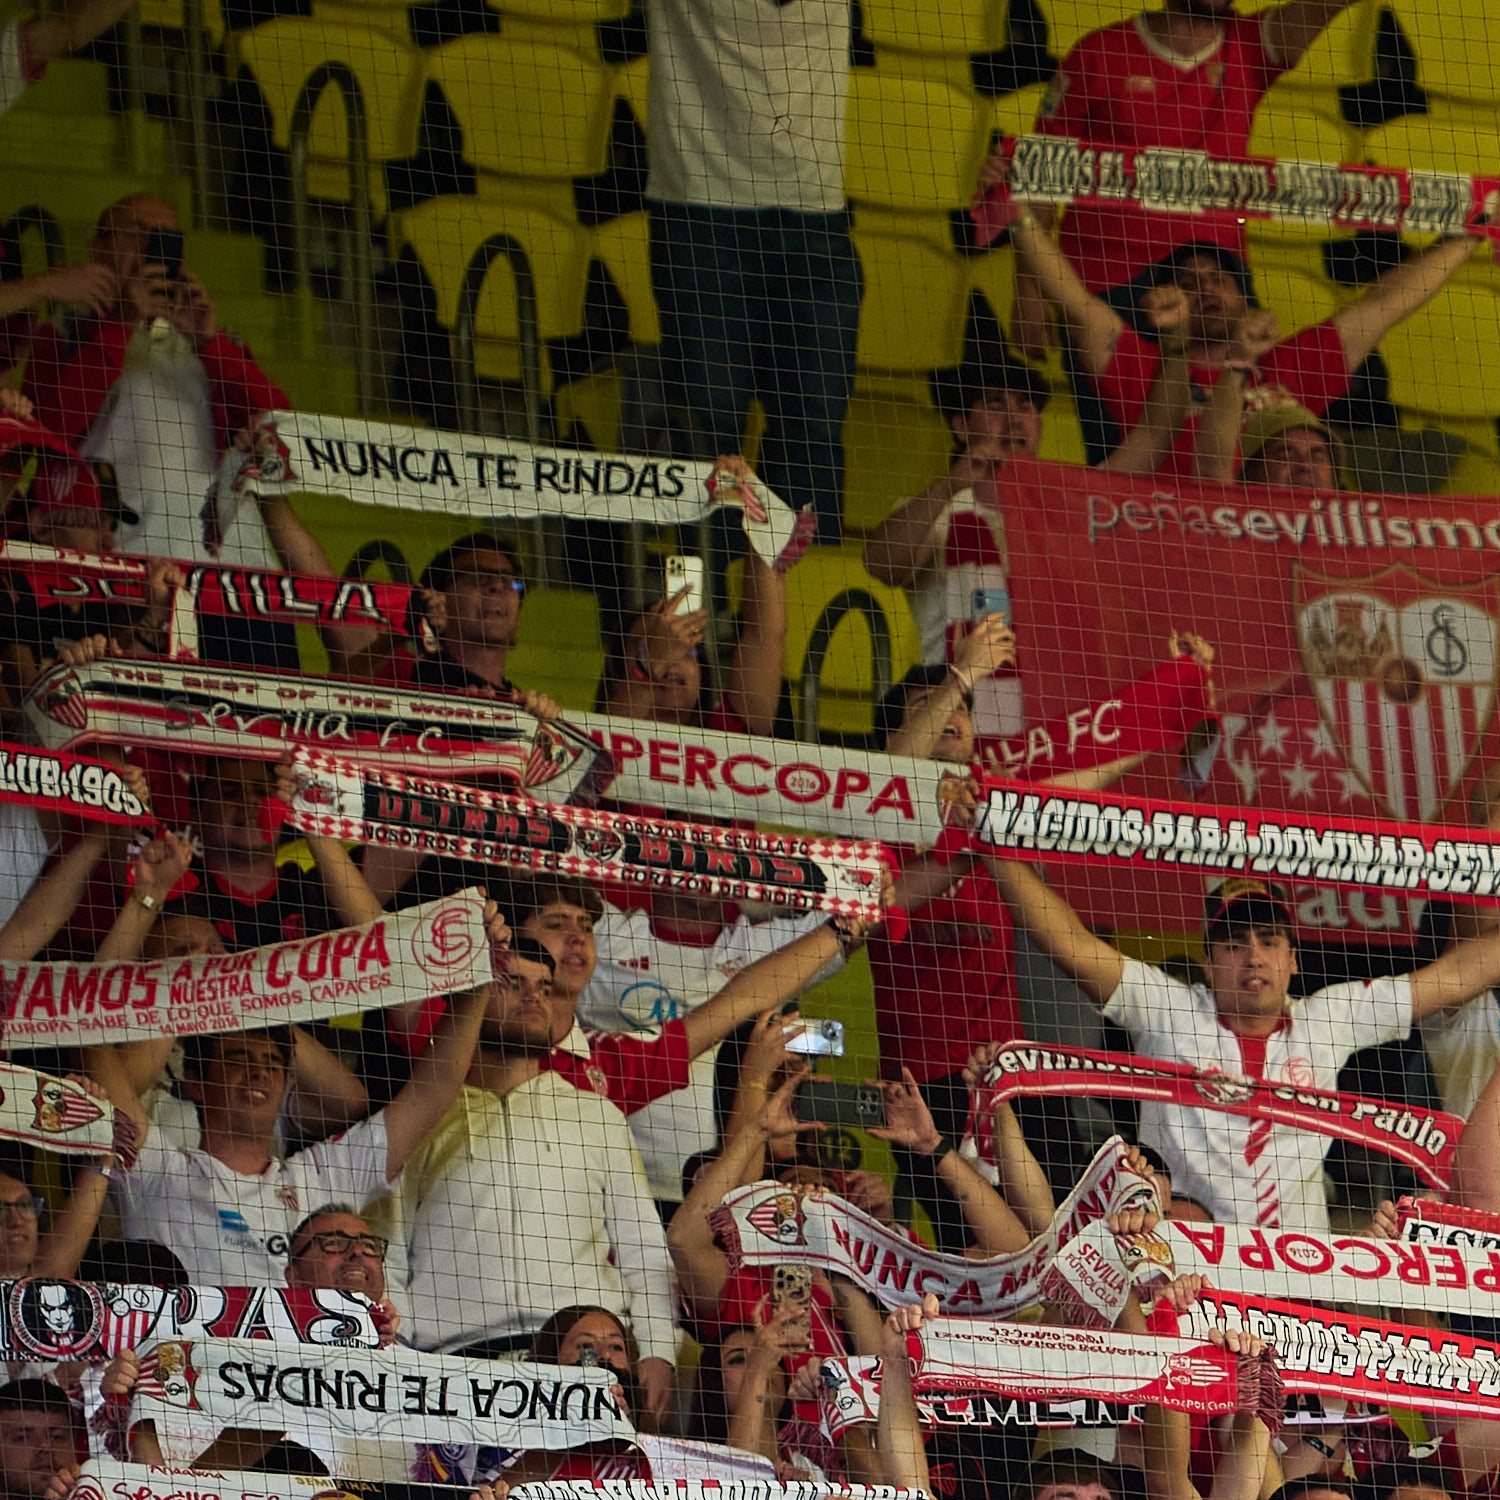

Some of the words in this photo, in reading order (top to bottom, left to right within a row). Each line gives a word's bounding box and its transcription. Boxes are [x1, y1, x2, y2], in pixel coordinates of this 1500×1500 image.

[304, 436, 459, 489] NUNCA
[466, 452, 522, 491] TE
[532, 455, 687, 500] RINDAS
[109, 667, 164, 685] THE
[275, 687, 316, 701] OF
[334, 694, 393, 710] THE
[409, 703, 514, 723] WORLD
[590, 728, 915, 820] PERCOPA
[362, 823, 462, 853] NOSOTROS
[722, 878, 752, 899] DEL
[202, 952, 256, 976] POR
[265, 921, 391, 988] COPA
[78, 1014, 126, 1031] SABE
[135, 1011, 161, 1026] DE
[166, 1008, 189, 1022] LO
[198, 1003, 233, 1020] QUE
[241, 991, 303, 1012] SOMOS
[309, 973, 391, 999] CAPACES
[170, 975, 254, 1006] NUESTRA
[832, 1221, 983, 1305] NUNCA
[1076, 1242, 1129, 1292] SEVILLA
[224, 1362, 387, 1410] RINDAS
[404, 1376, 459, 1416] TE
[470, 1382, 622, 1420] NUNCA
